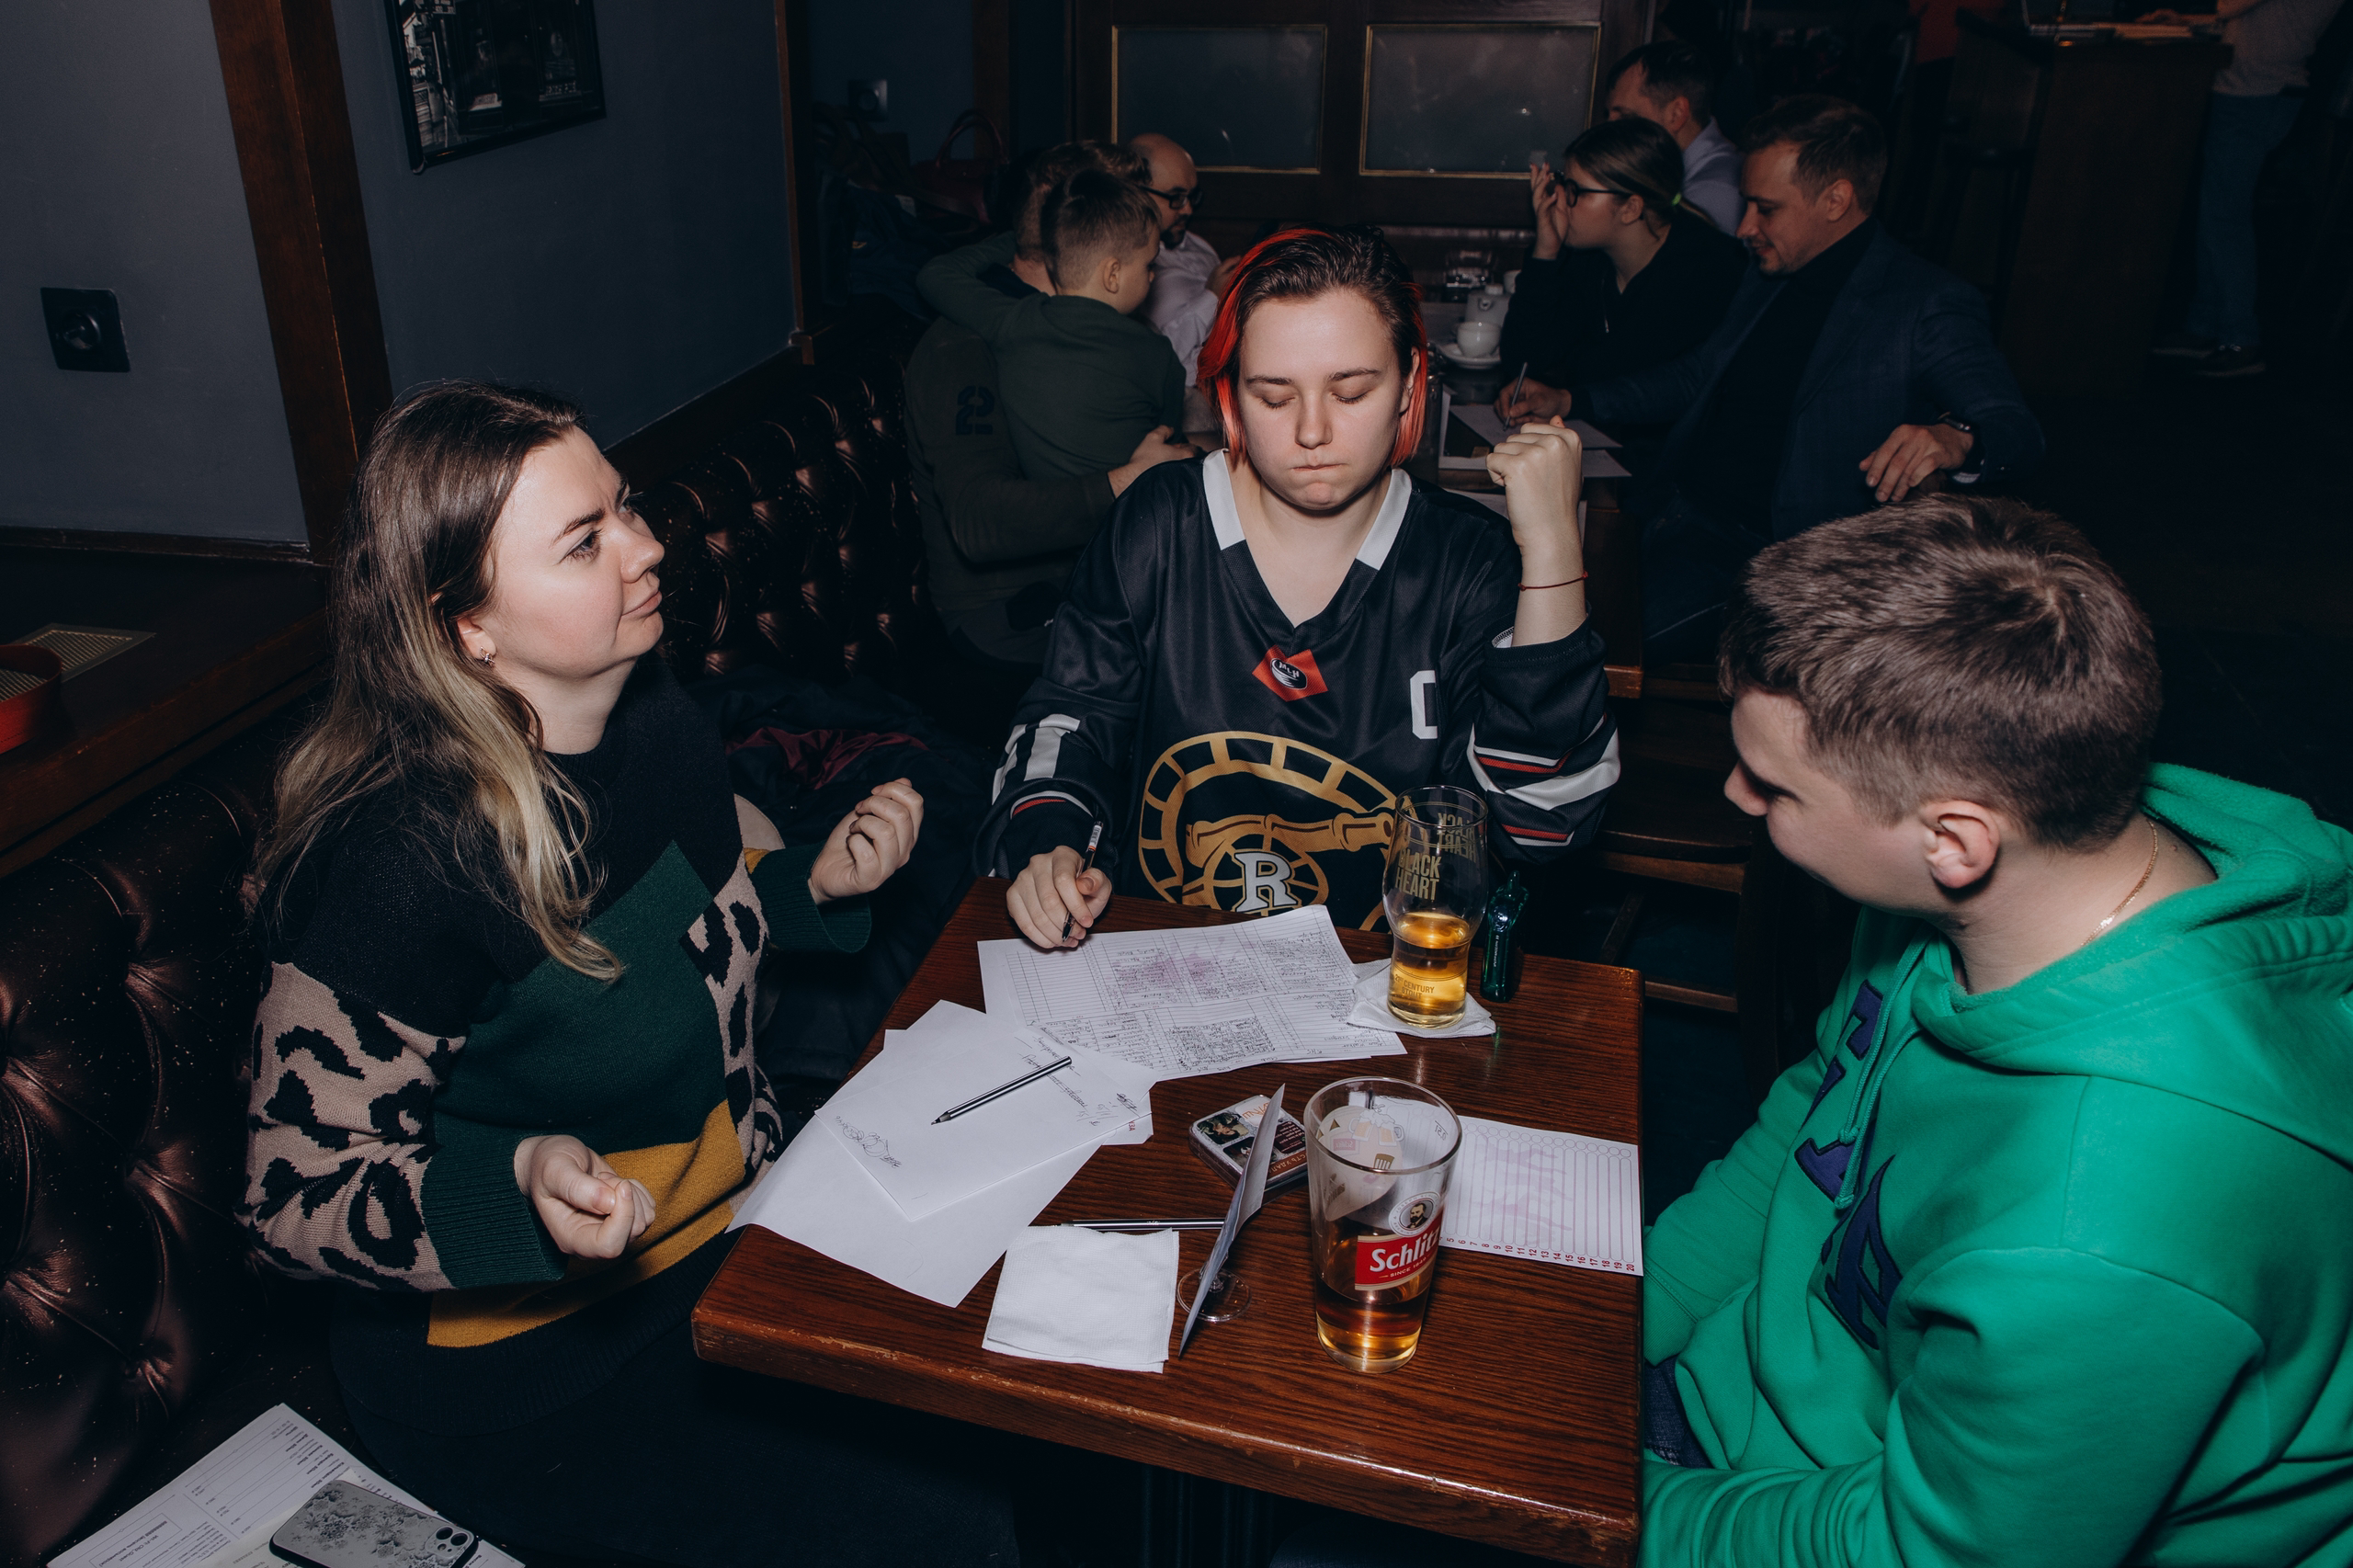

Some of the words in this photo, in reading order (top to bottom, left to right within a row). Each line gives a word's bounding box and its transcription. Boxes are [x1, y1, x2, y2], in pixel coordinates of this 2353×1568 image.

[954, 385, 995, 437] 2
[1279, 661, 1300, 678] MLH
[1398, 848, 1442, 880] BLACK
[1233, 848, 1302, 914] R
[1394, 871, 1440, 901] HEART
[1401, 986, 1423, 1000] STOUT
[1404, 979, 1436, 995] CENTURY
[1370, 1230, 1440, 1273] Schlitz
[1529, 1248, 1537, 1256] 12
[1390, 1267, 1411, 1278] SINCE
[1626, 1264, 1634, 1272] 20
